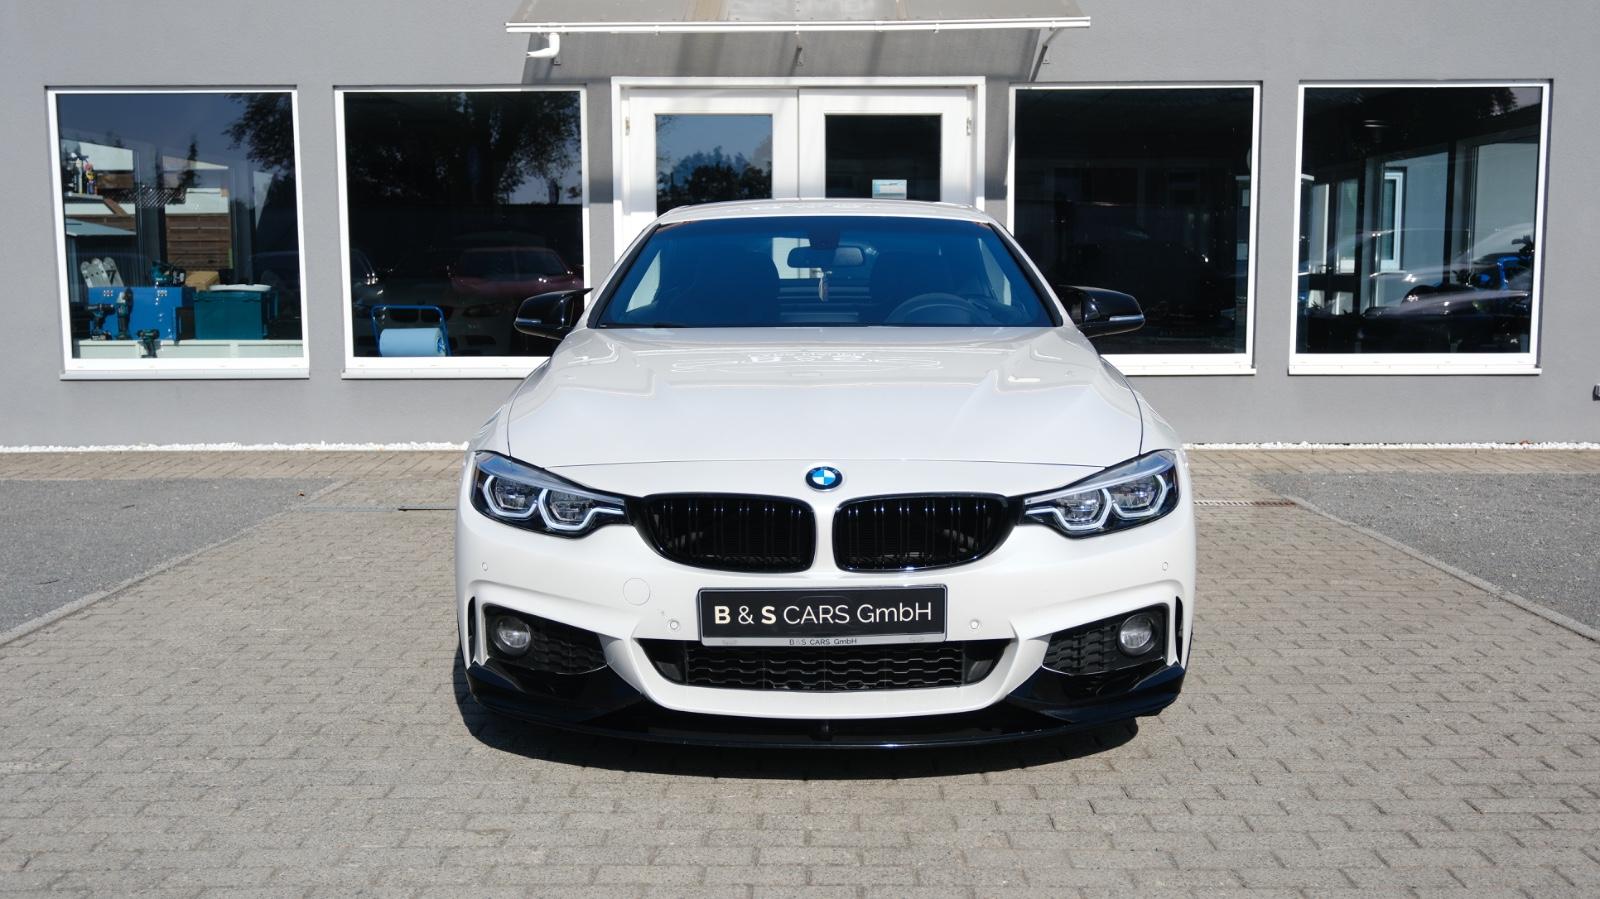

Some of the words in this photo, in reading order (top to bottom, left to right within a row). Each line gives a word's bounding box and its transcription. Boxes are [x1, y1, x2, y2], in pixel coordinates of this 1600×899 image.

[714, 605, 731, 625] B
[738, 605, 755, 625] &
[761, 605, 777, 625] S
[783, 604, 850, 625] CARS
[857, 602, 932, 624] GmbH
